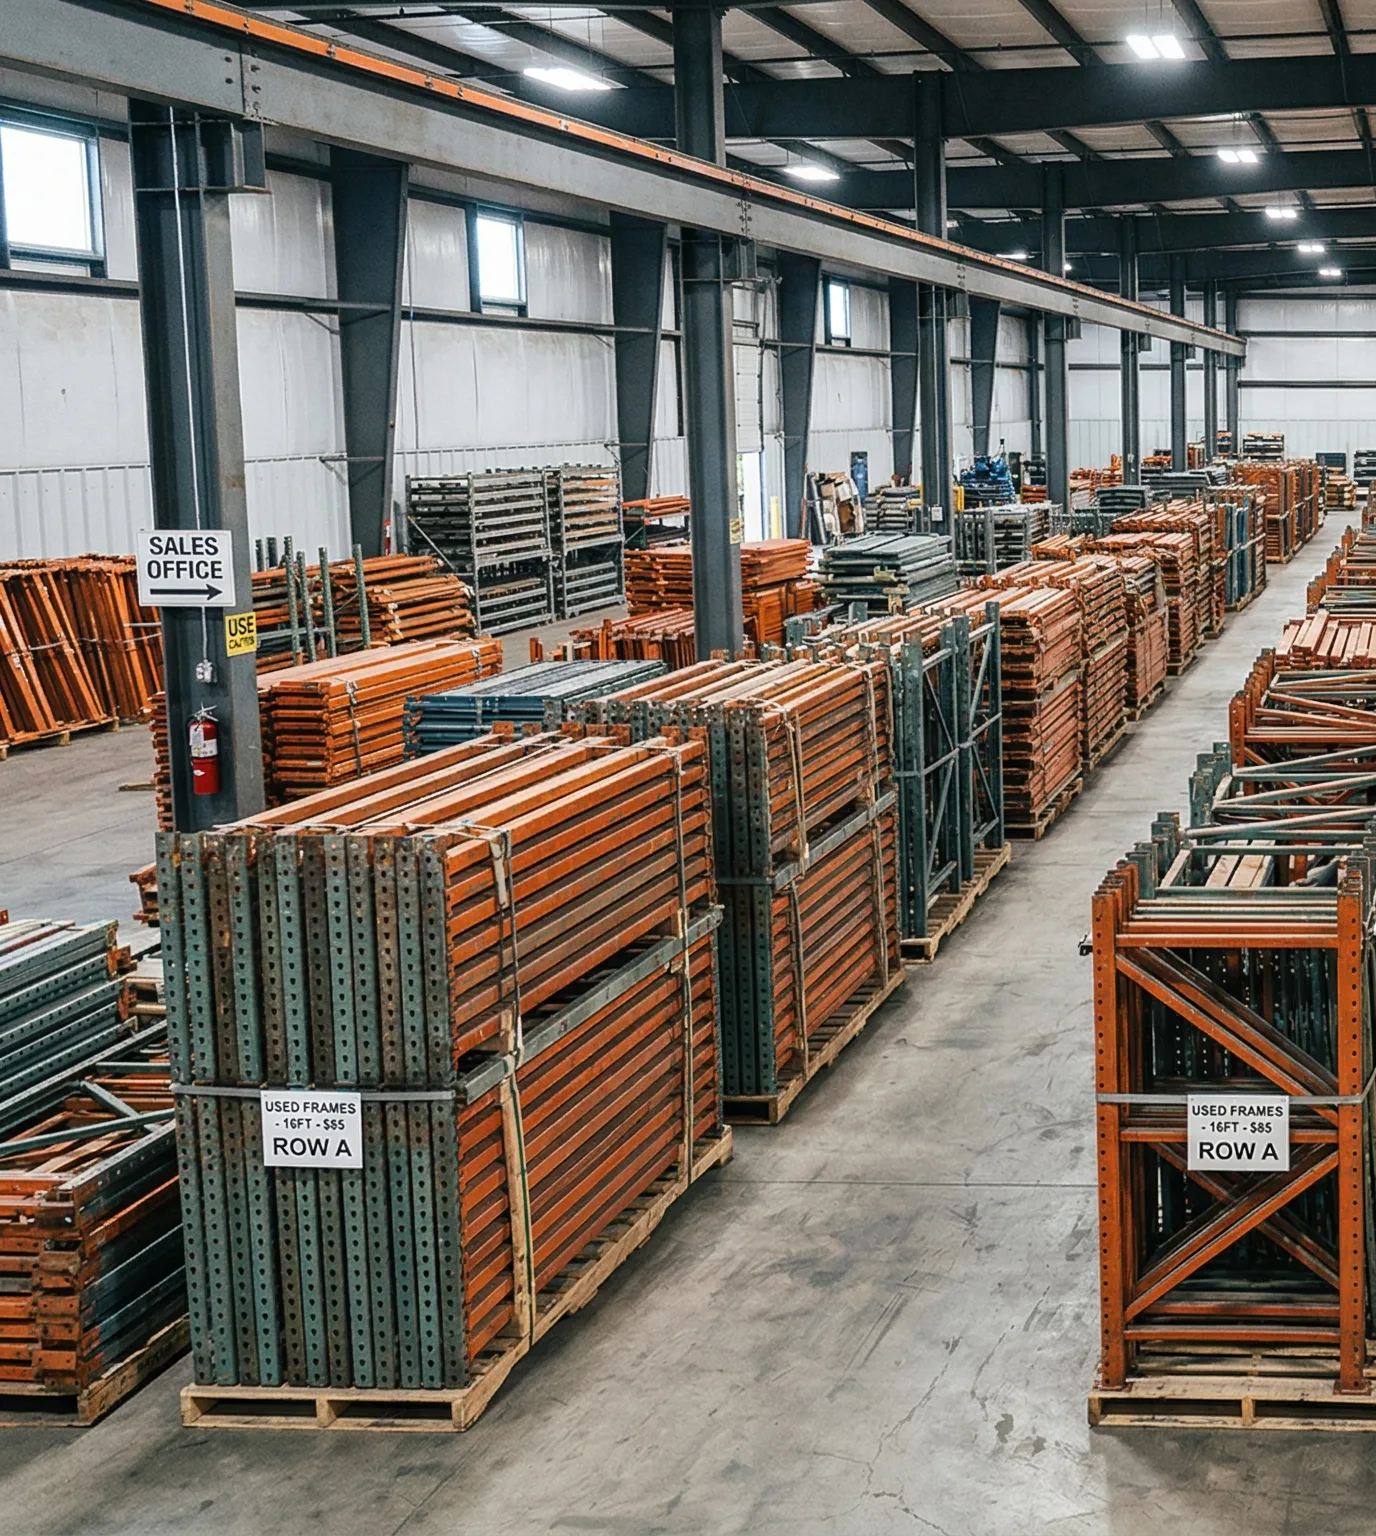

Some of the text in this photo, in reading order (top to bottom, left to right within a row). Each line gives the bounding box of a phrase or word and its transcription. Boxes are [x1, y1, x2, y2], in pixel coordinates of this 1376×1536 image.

[149, 536, 219, 556] SALES
[147, 560, 223, 579] OFFICE
[228, 616, 254, 637] USE
[265, 1101, 356, 1114] USED FRAMES
[1192, 1105, 1283, 1117] USED FRAMES
[283, 1118, 312, 1129] 16FT
[1210, 1121, 1239, 1132] 16FT
[1250, 1122, 1272, 1134] $85
[273, 1137, 352, 1157] ROW A
[1199, 1142, 1279, 1160] ROW A
